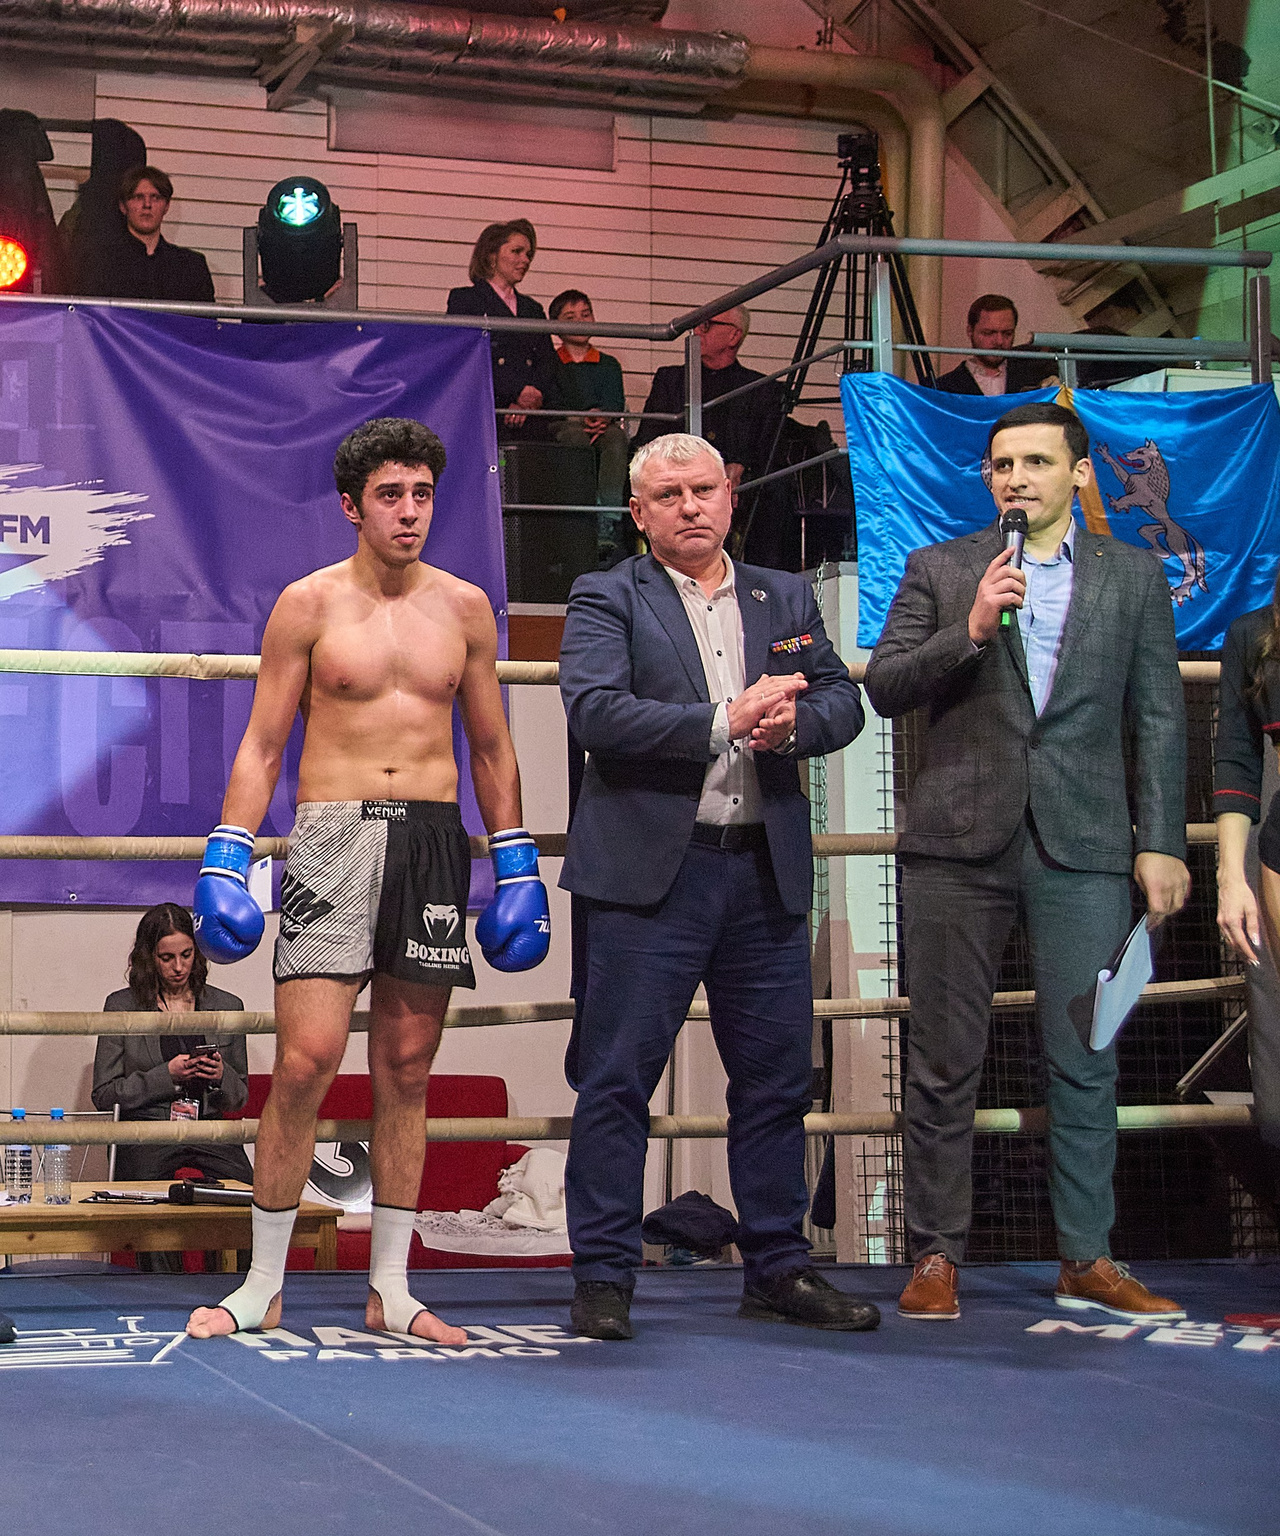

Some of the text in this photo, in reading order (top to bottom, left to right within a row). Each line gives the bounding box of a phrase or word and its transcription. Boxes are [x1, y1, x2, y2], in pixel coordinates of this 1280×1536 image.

[366, 806, 406, 816] VENUM
[405, 938, 470, 963] BOXING
[258, 1346, 561, 1361] РАДИО
